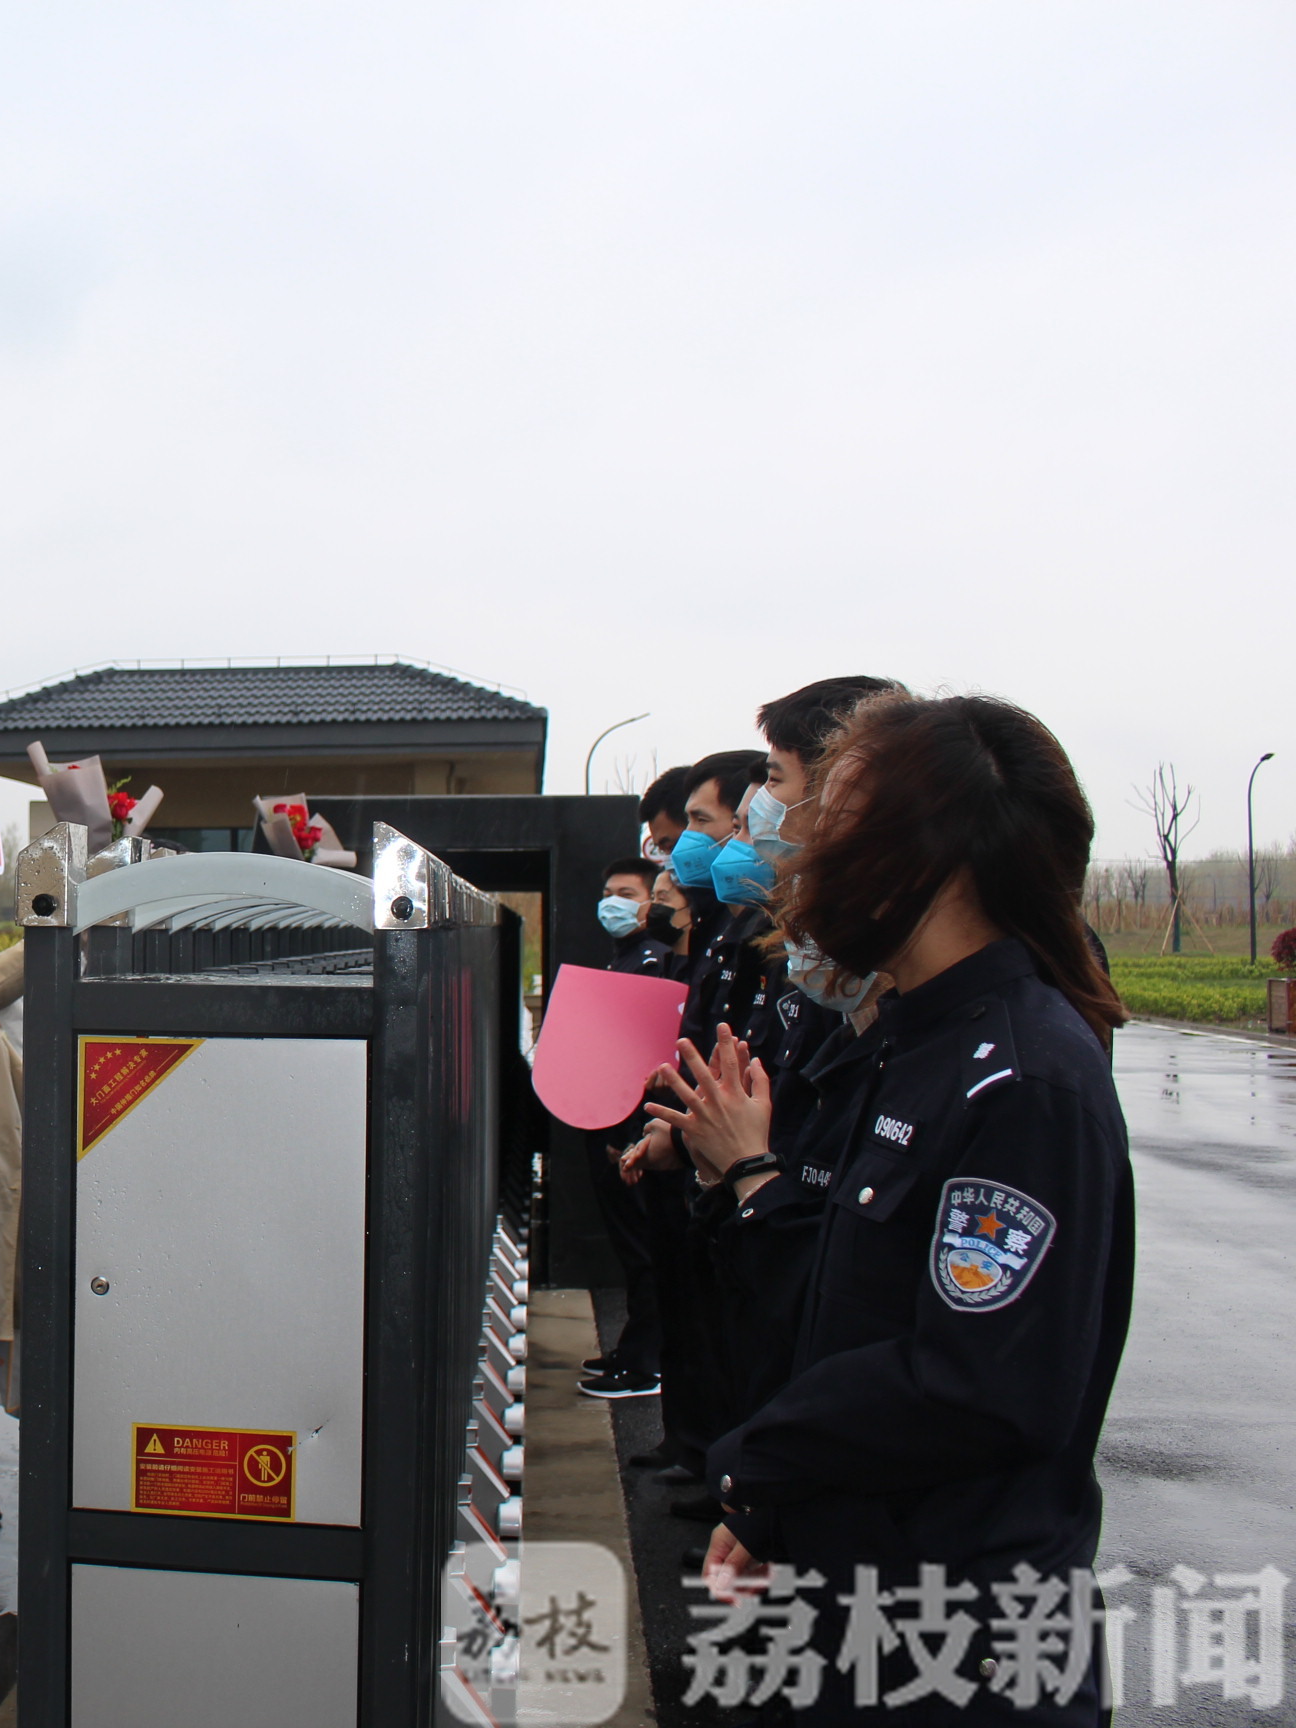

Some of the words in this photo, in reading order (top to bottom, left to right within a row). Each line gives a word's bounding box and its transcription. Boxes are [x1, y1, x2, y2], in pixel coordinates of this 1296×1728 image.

[875, 1114, 913, 1146] 090642
[951, 1187, 1045, 1236] 中华人民共和国
[961, 1238, 1003, 1261] POLICE
[959, 1252, 993, 1271] 公安
[174, 1437, 228, 1450] DANGER
